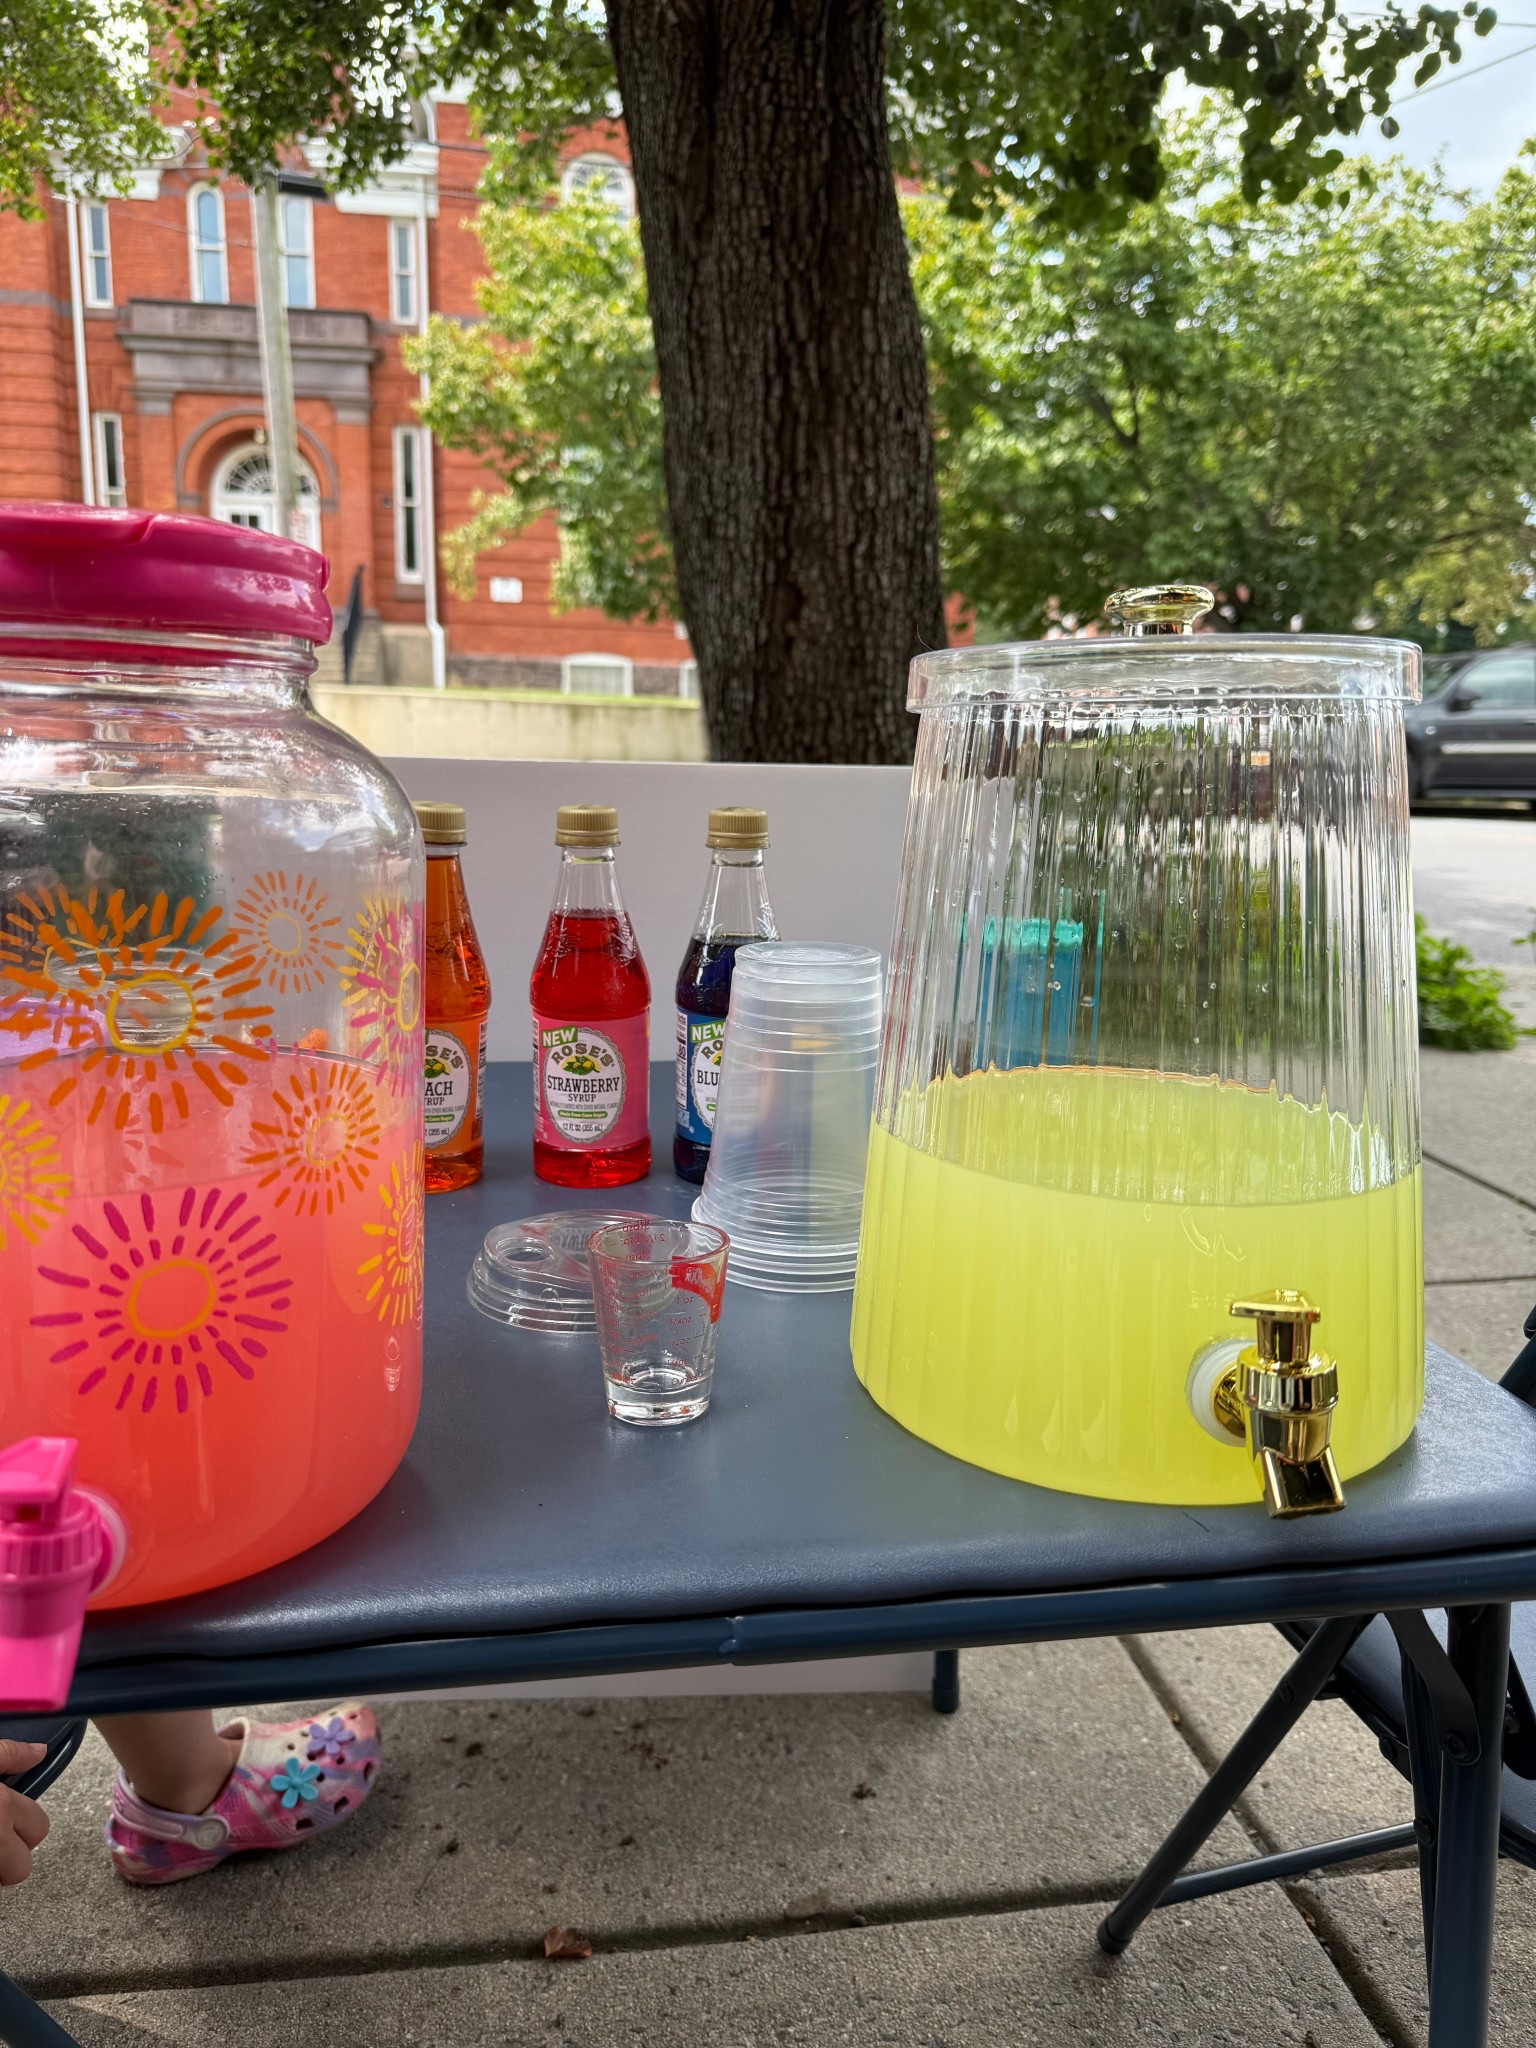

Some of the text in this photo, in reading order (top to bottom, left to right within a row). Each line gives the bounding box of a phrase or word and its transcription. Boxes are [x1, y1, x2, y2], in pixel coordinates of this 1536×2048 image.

[542, 1028, 575, 1046] NEW
[692, 1022, 726, 1040] NEW
[425, 1045, 463, 1069] SE'S
[551, 1043, 614, 1067] ROSE'S
[701, 1040, 723, 1059] RO
[547, 1075, 620, 1093] STRAWBERRY
[697, 1070, 720, 1086] BLU
[425, 1081, 453, 1096] ACH
[425, 1097, 445, 1106] RUP
[568, 1093, 597, 1103] SYRUP
